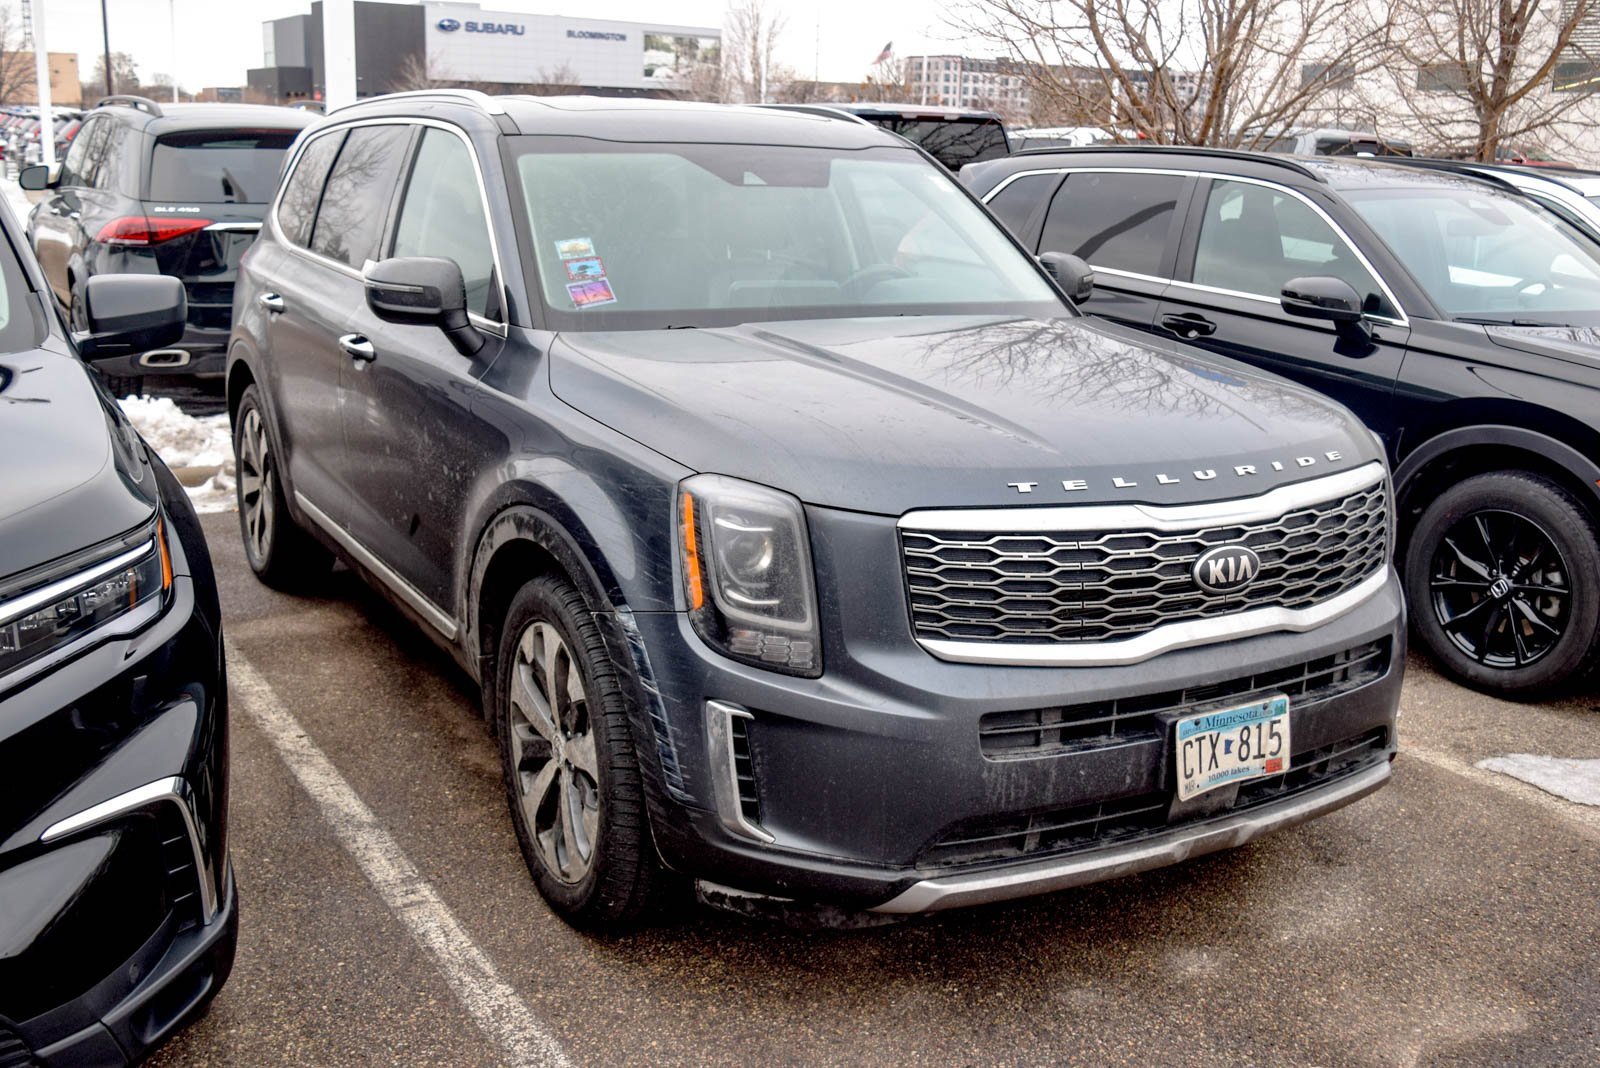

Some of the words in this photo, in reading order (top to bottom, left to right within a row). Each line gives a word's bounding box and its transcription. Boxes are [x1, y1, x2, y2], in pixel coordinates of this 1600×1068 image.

[464, 21, 525, 36] SUBARU
[566, 29, 627, 42] BLOOMINGTON
[1007, 450, 1343, 493] TELLURIDE
[1208, 555, 1253, 585] KIA
[1204, 709, 1258, 728] Minnesota
[1183, 732, 1220, 779] CTX
[1238, 719, 1282, 761] 815
[1208, 770, 1229, 782] 10,000
[1230, 766, 1250, 777] lakes
